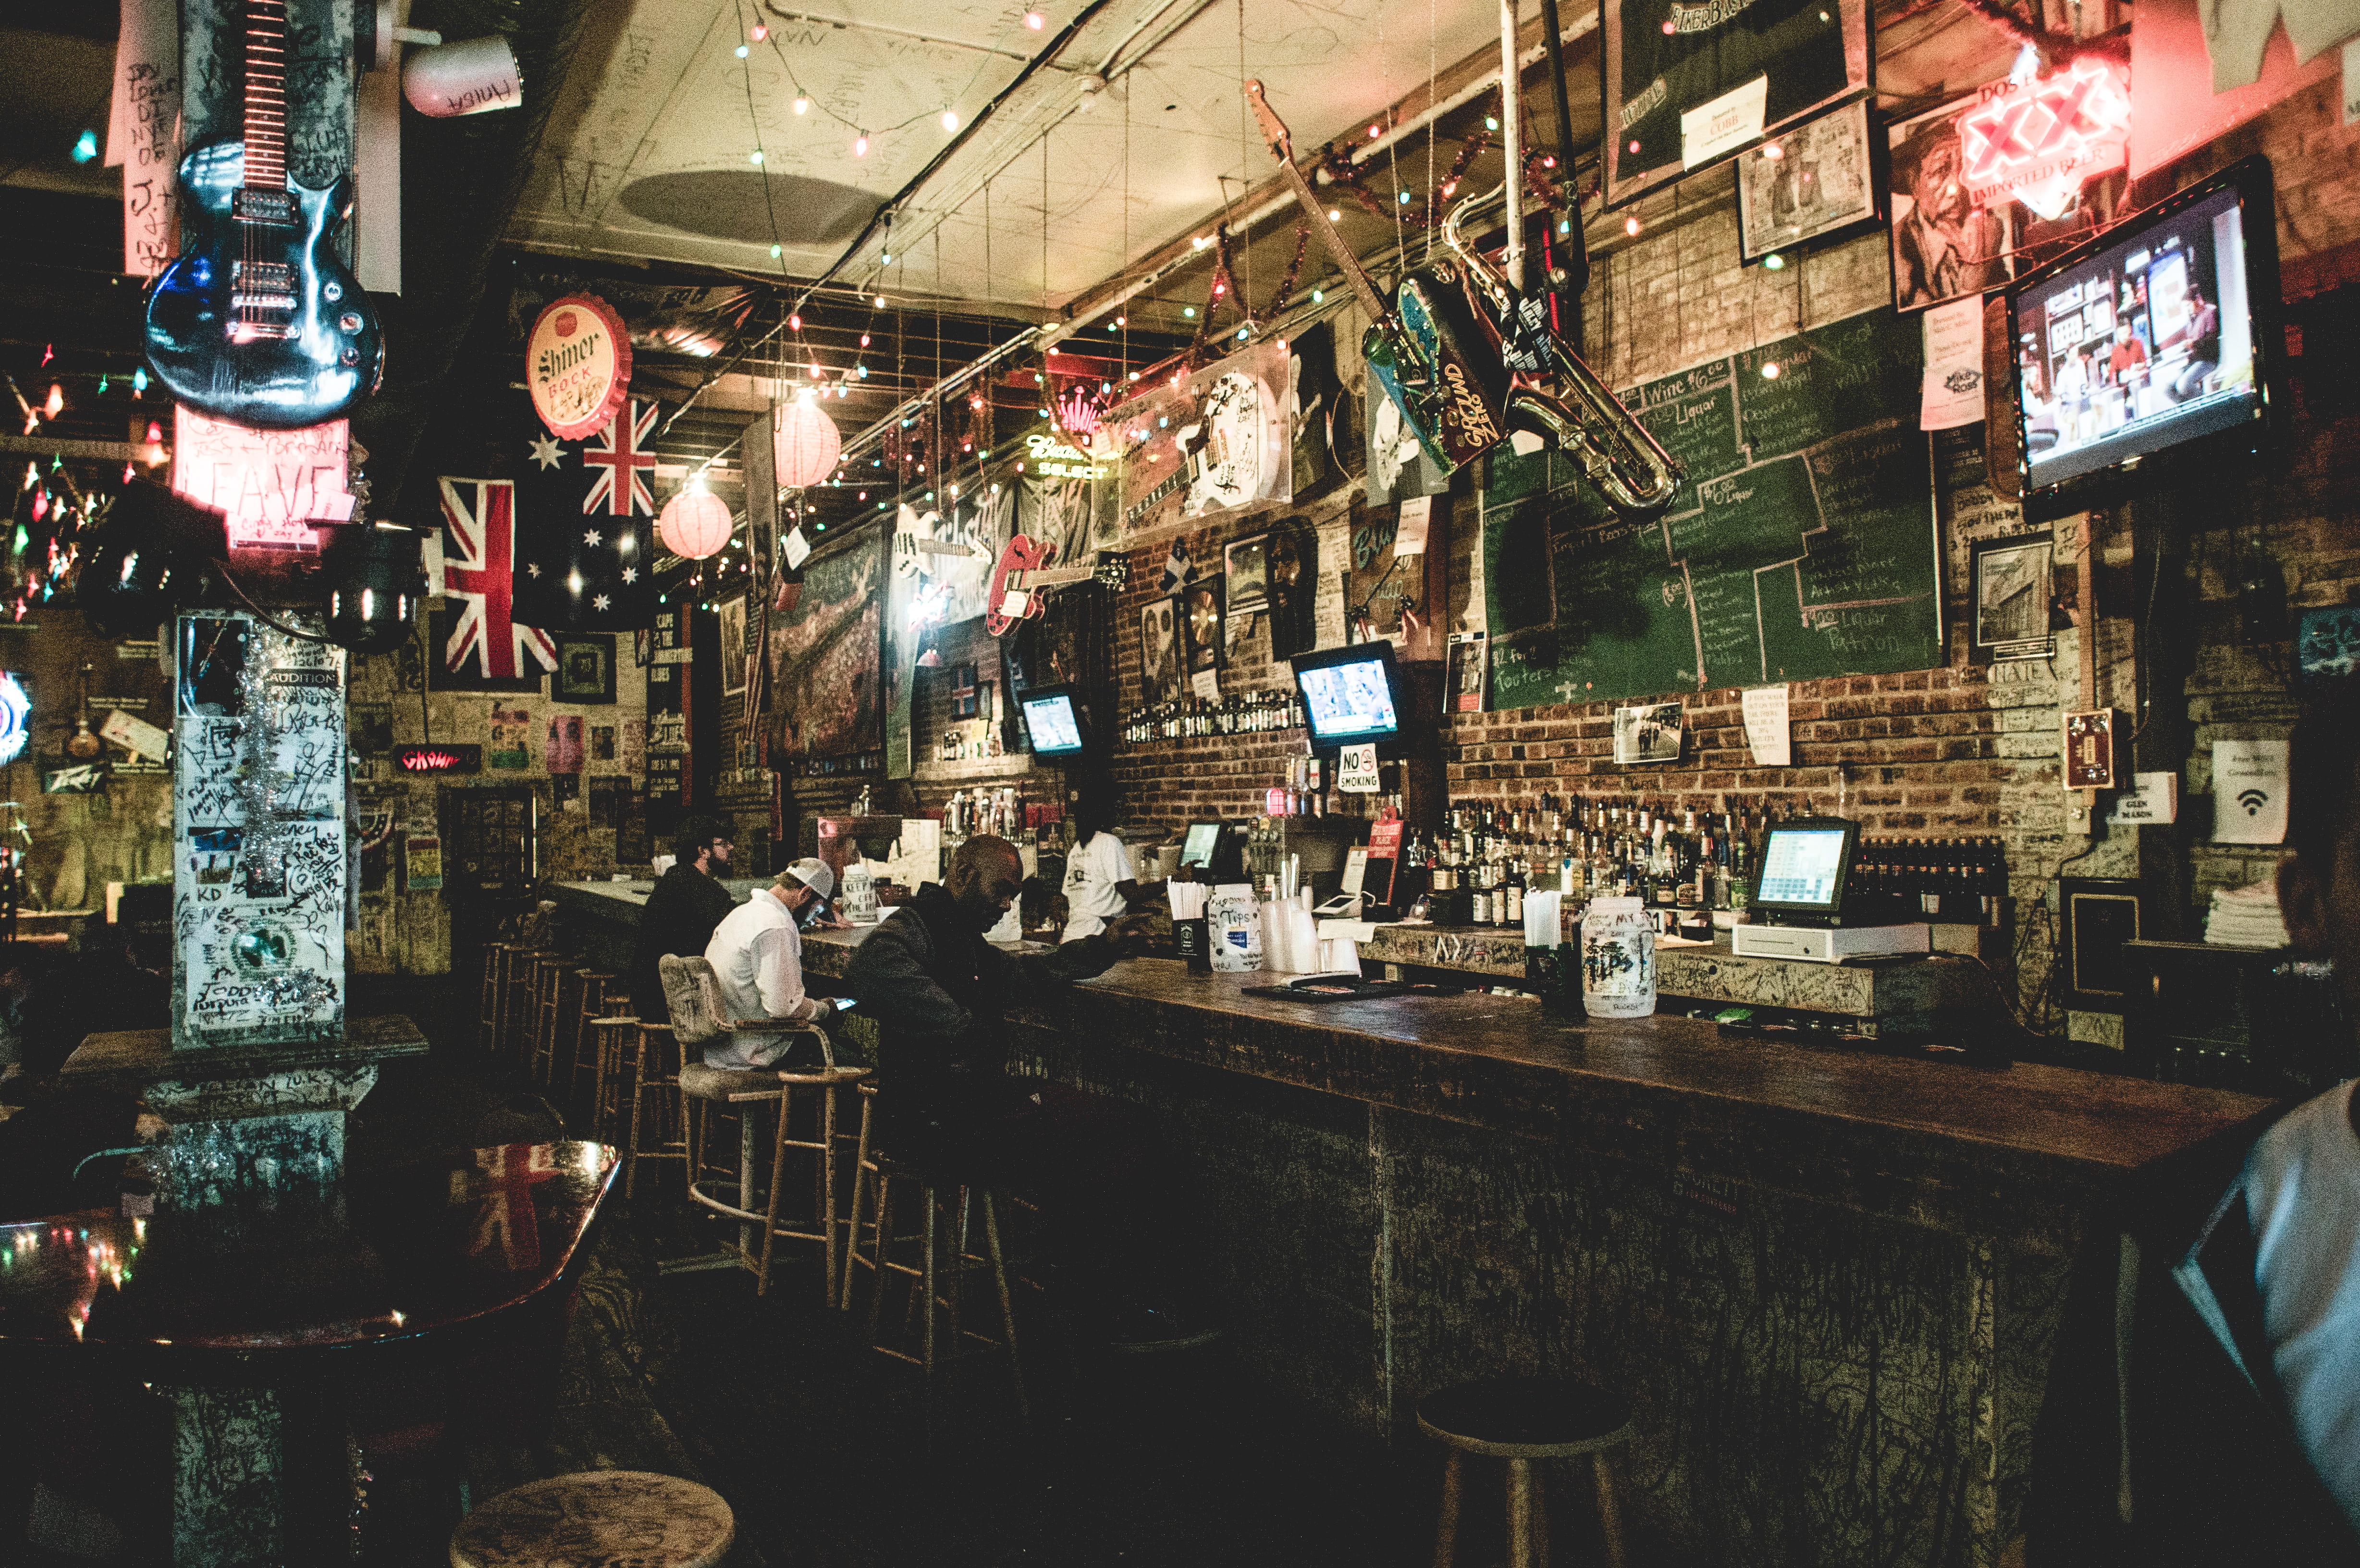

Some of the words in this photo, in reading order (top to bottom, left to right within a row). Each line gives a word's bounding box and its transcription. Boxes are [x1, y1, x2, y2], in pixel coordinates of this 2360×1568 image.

[1973, 165, 2054, 204] IMPORTED
[2059, 147, 2103, 175] BEER
[538, 333, 600, 384] Shiner
[549, 367, 591, 398] BOCK
[1647, 380, 1686, 404] Wine
[1444, 363, 1483, 447] GROUND
[1471, 393, 1500, 442] ZERO
[1038, 462, 1108, 480] SELECT
[1825, 626, 1901, 652] Patron
[270, 673, 336, 684] AUDITION
[1343, 752, 1359, 770] NO
[1341, 775, 1377, 788] SMOKING
[1219, 908, 1250, 927] Tips
